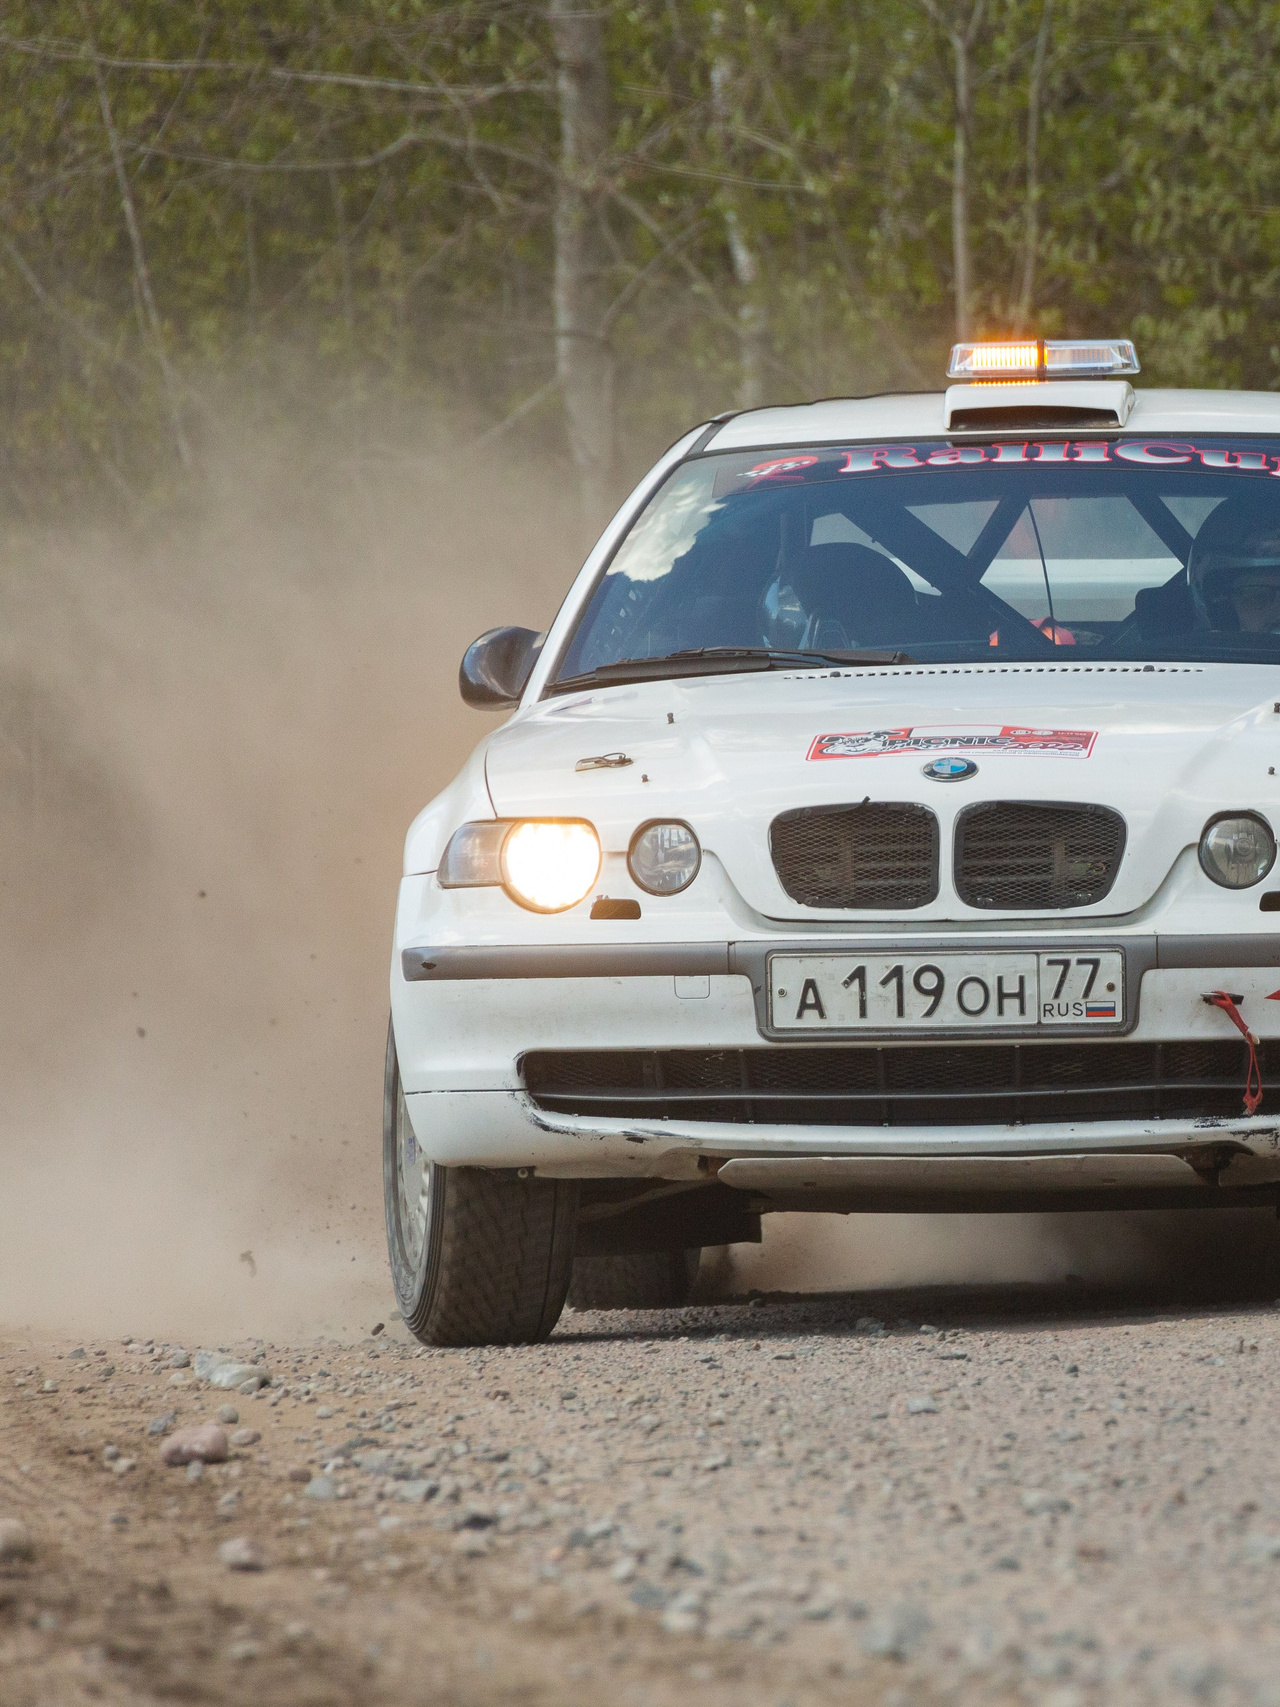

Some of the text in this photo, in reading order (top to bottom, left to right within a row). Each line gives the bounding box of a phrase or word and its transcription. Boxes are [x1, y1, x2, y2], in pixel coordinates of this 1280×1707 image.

[882, 736, 1014, 747] PICNIC
[1046, 957, 1101, 1000] 77
[1043, 1002, 1084, 1018] RUS
